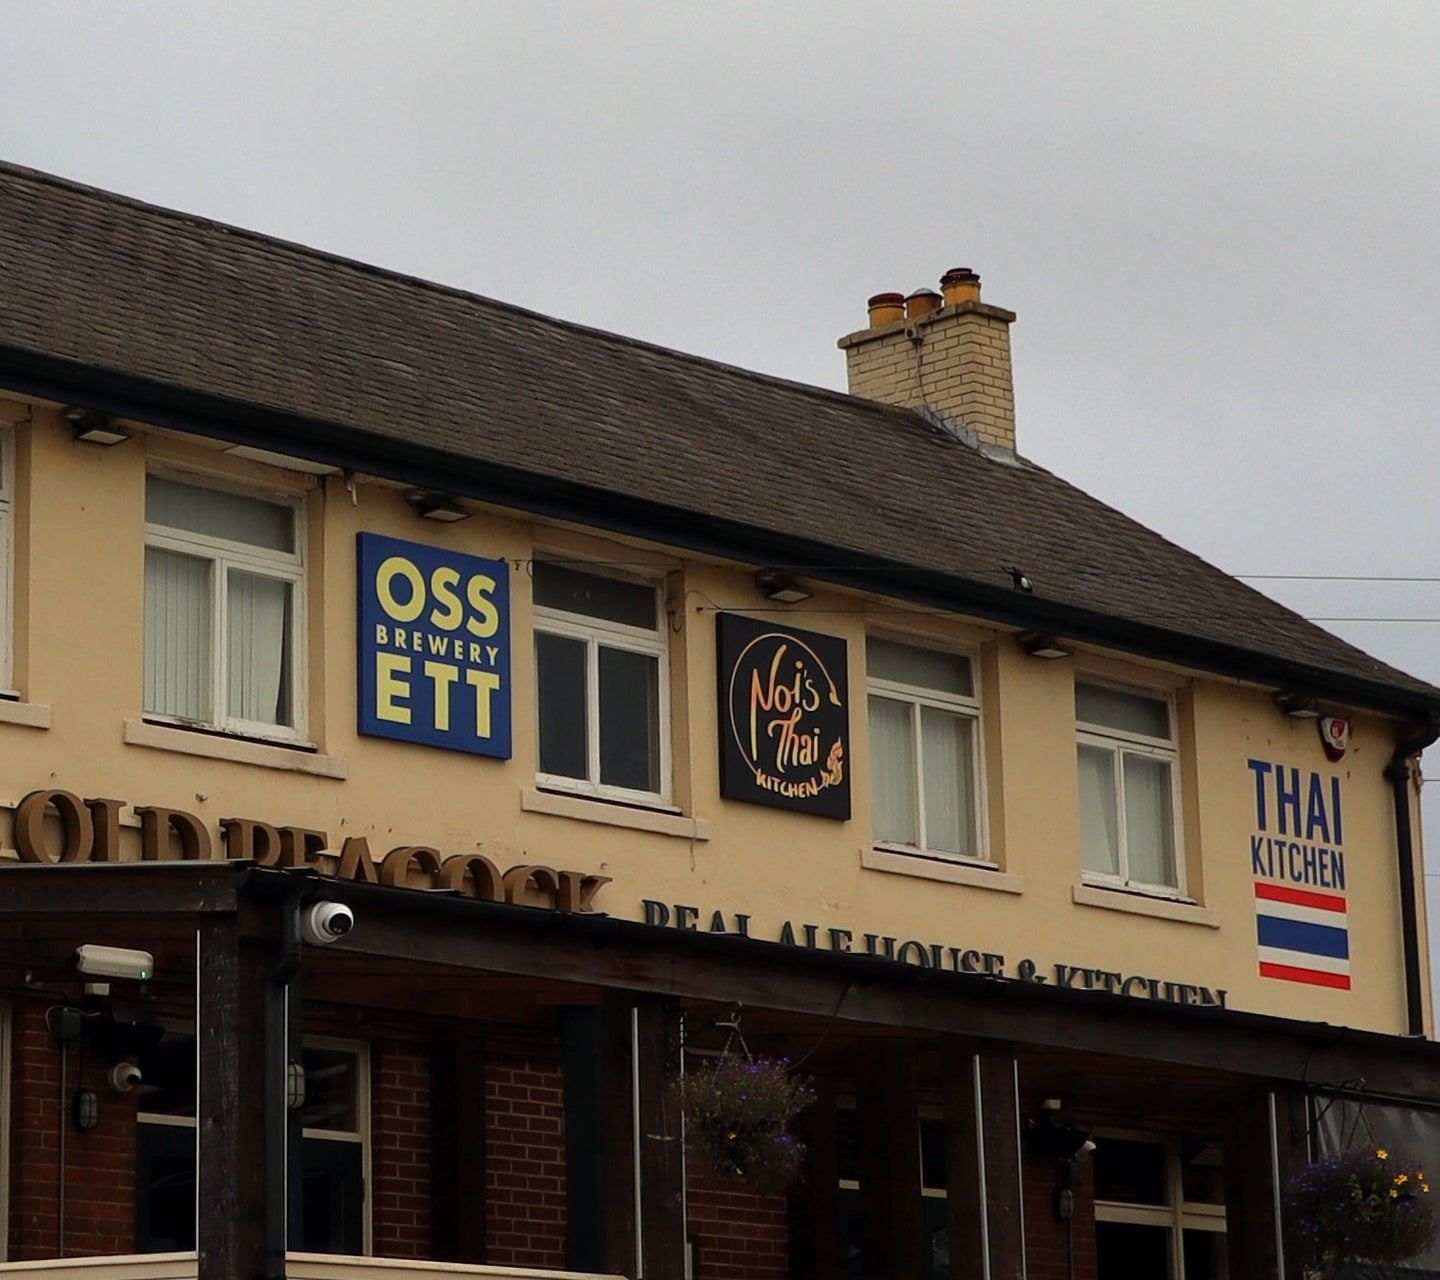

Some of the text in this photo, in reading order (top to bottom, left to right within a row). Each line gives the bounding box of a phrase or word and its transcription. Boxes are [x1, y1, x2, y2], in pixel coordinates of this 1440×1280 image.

[376, 557, 499, 638] OSS
[376, 624, 499, 666] BREWERY
[377, 651, 500, 739] ETT
[751, 644, 820, 761] Noi's
[768, 708, 820, 773] Thai
[756, 768, 819, 798] KITCHEN
[1248, 759, 1342, 845] THAI
[15, 789, 212, 863] OLD
[1251, 835, 1345, 890] KITCHEN
